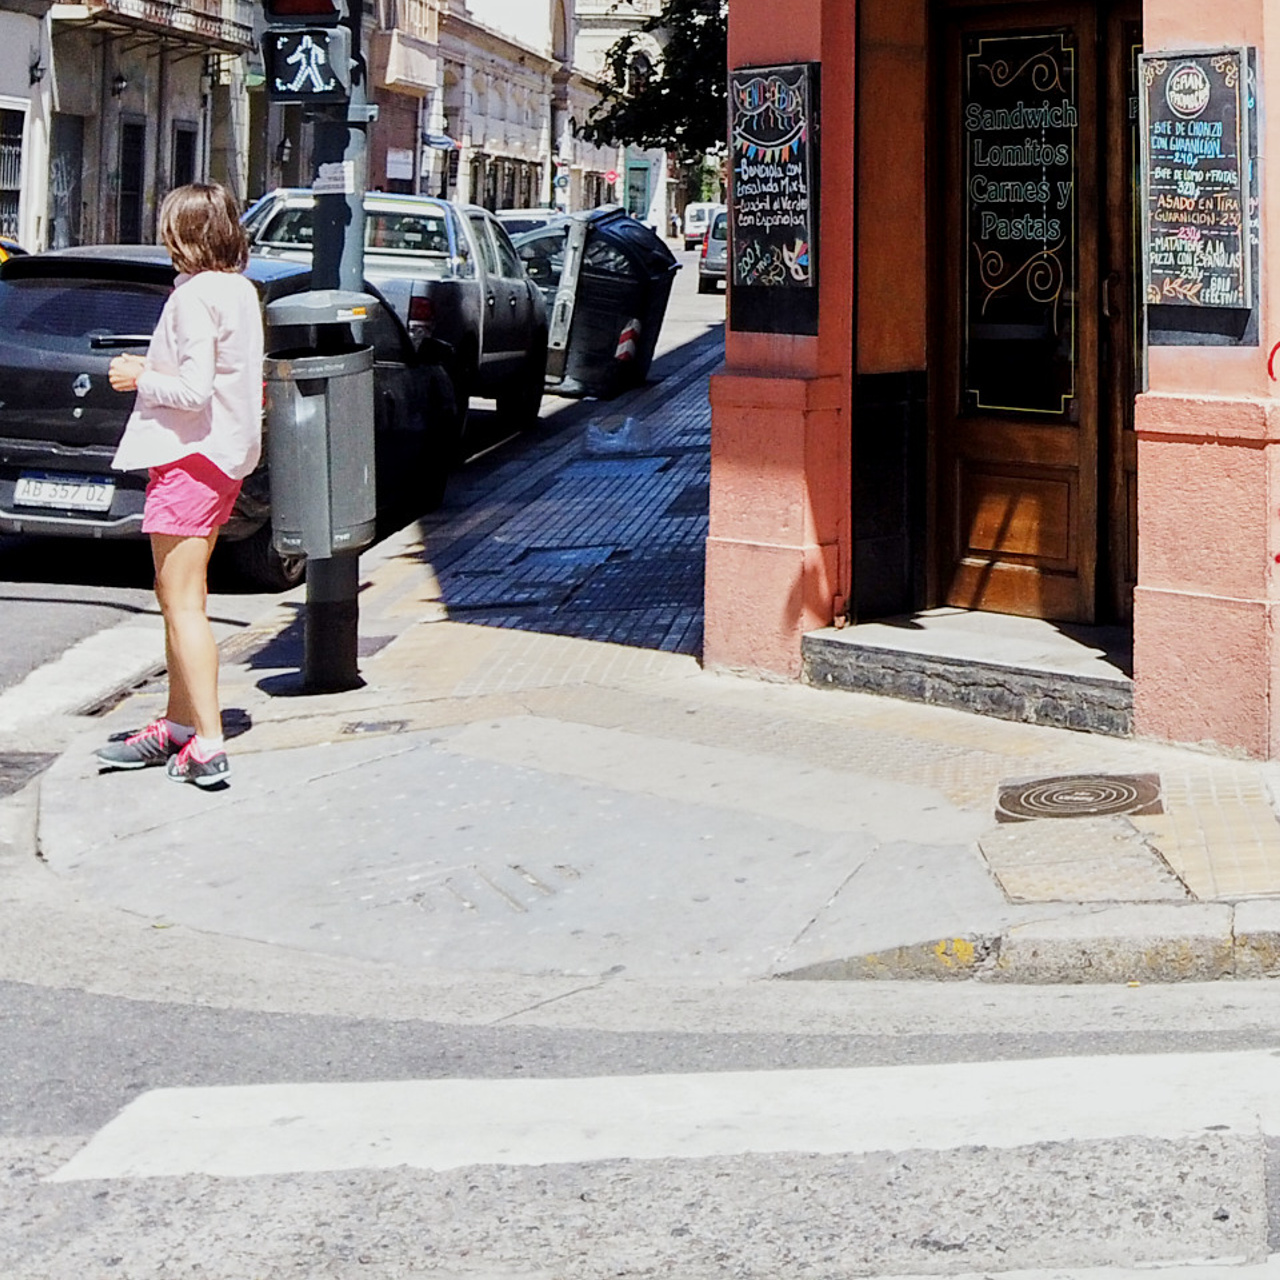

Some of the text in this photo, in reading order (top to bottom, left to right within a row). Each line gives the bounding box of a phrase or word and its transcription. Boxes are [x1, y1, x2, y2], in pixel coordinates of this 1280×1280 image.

[965, 98, 1078, 132] Sandwich
[974, 137, 1069, 167] Lomitos
[970, 174, 1073, 210] Carnes y
[1198, 197, 1214, 210] EN
[981, 211, 1061, 240] Pastas
[1149, 251, 1175, 266] PIZZA
